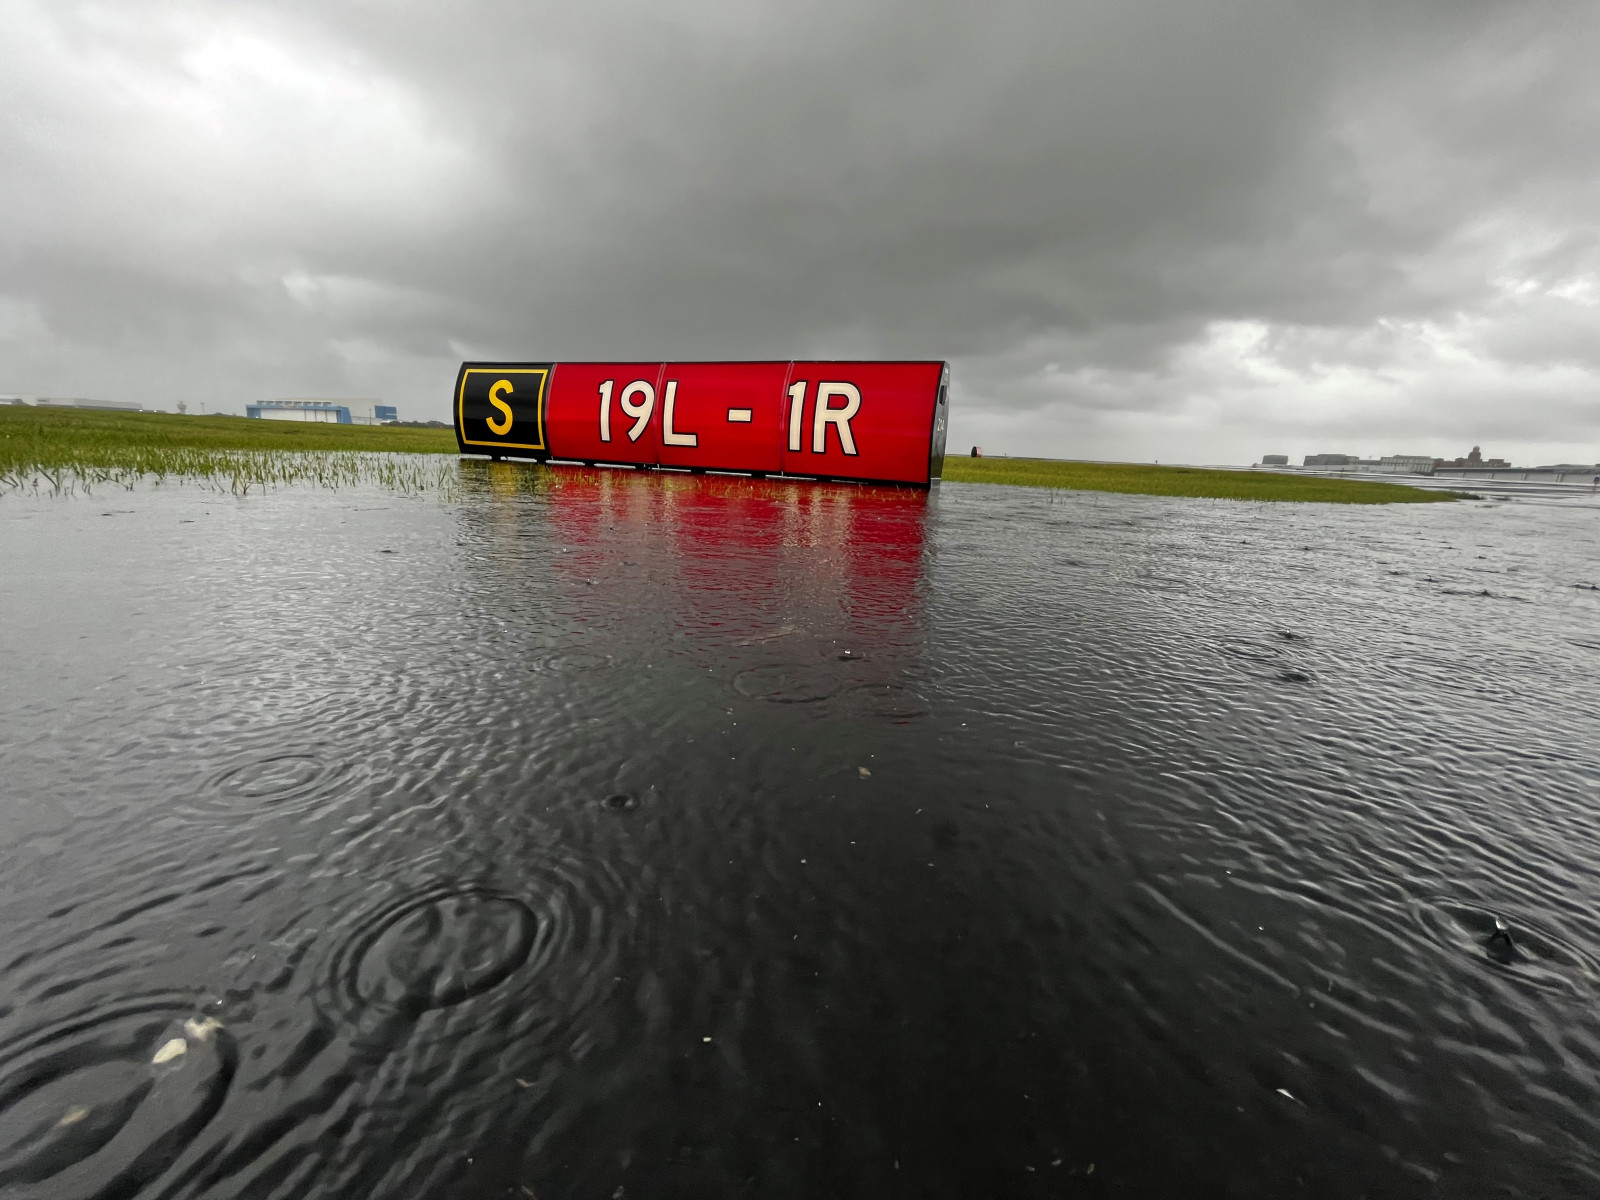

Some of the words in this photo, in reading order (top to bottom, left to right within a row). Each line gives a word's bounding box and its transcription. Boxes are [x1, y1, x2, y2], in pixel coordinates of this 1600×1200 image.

[485, 379, 514, 435] S
[599, 380, 698, 447] 19L
[728, 408, 752, 422] -
[787, 381, 861, 455] 1R
